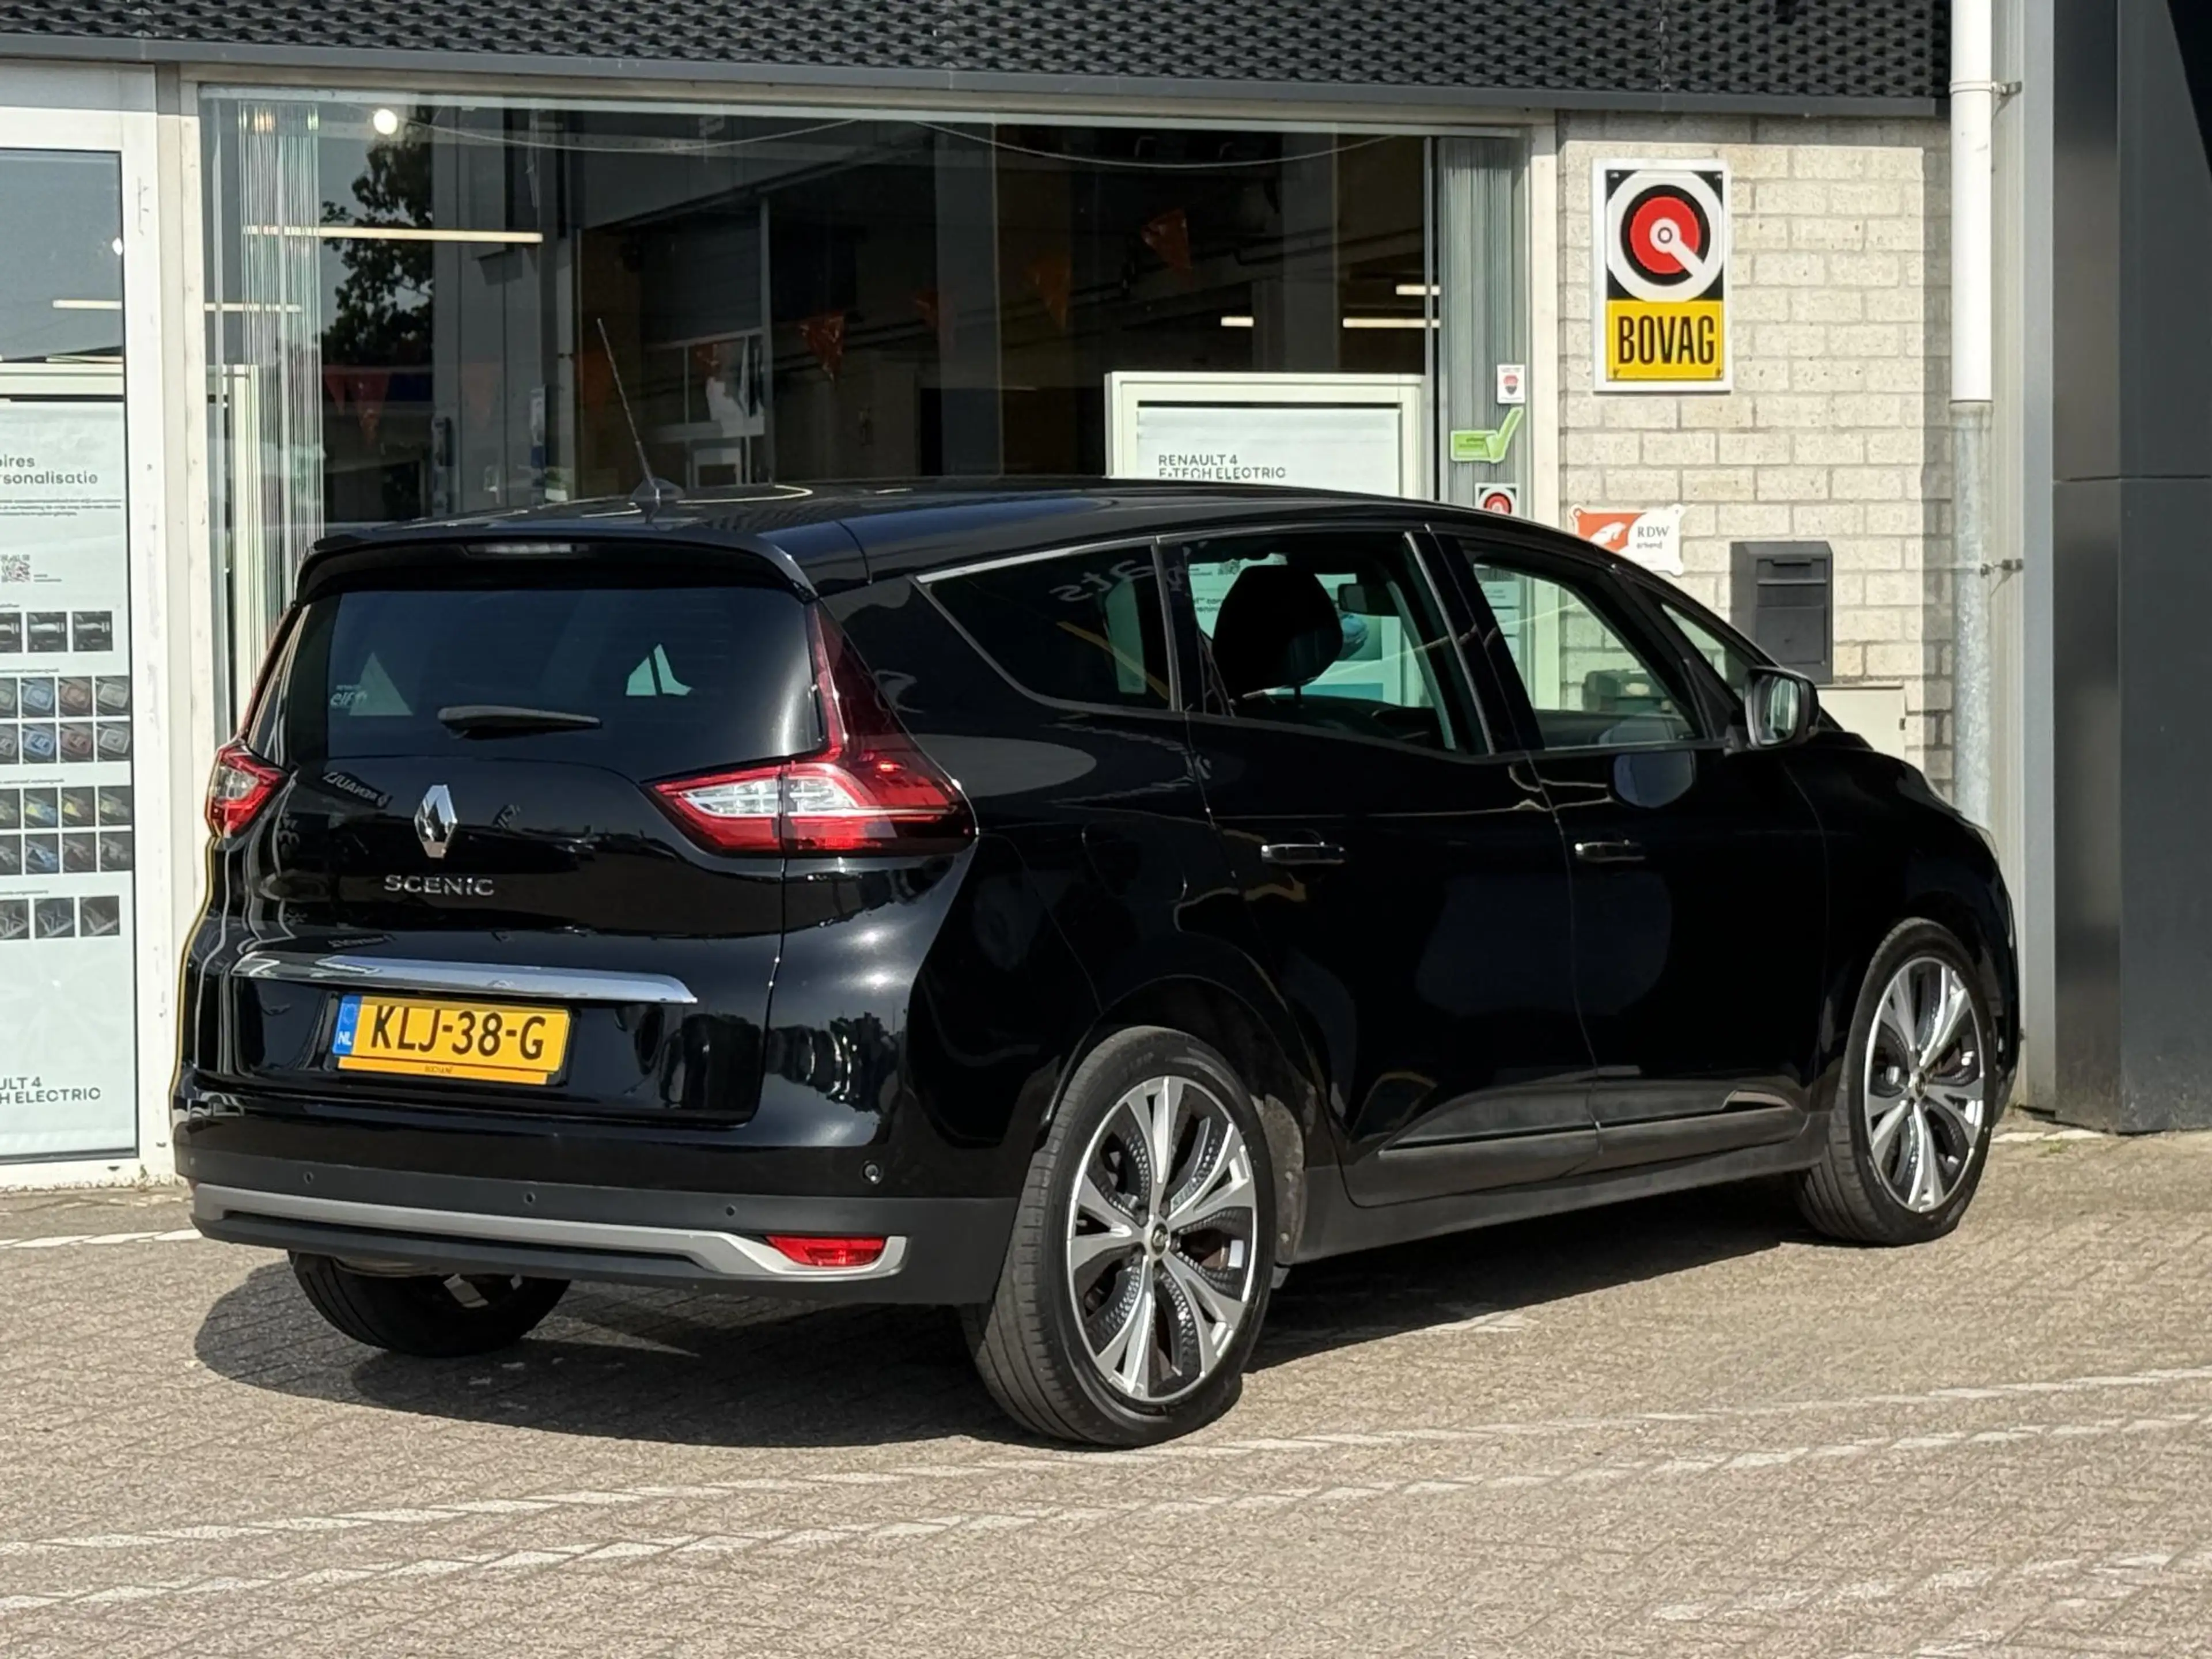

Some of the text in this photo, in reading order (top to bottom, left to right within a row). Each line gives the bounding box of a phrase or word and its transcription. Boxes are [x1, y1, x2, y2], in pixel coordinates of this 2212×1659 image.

[1618, 315, 1714, 365] BOVAG
[1158, 454, 1238, 466] RENAULT 4
[1215, 467, 1286, 480] ELECTRIC
[1637, 525, 1671, 538] RDW
[384, 874, 495, 896] SCENIC
[338, 1031, 353, 1046] NL
[370, 1005, 546, 1060] KLJ-38-G
[31, 1076, 43, 1088] 4
[15, 1087, 101, 1104] ELECTRIC
